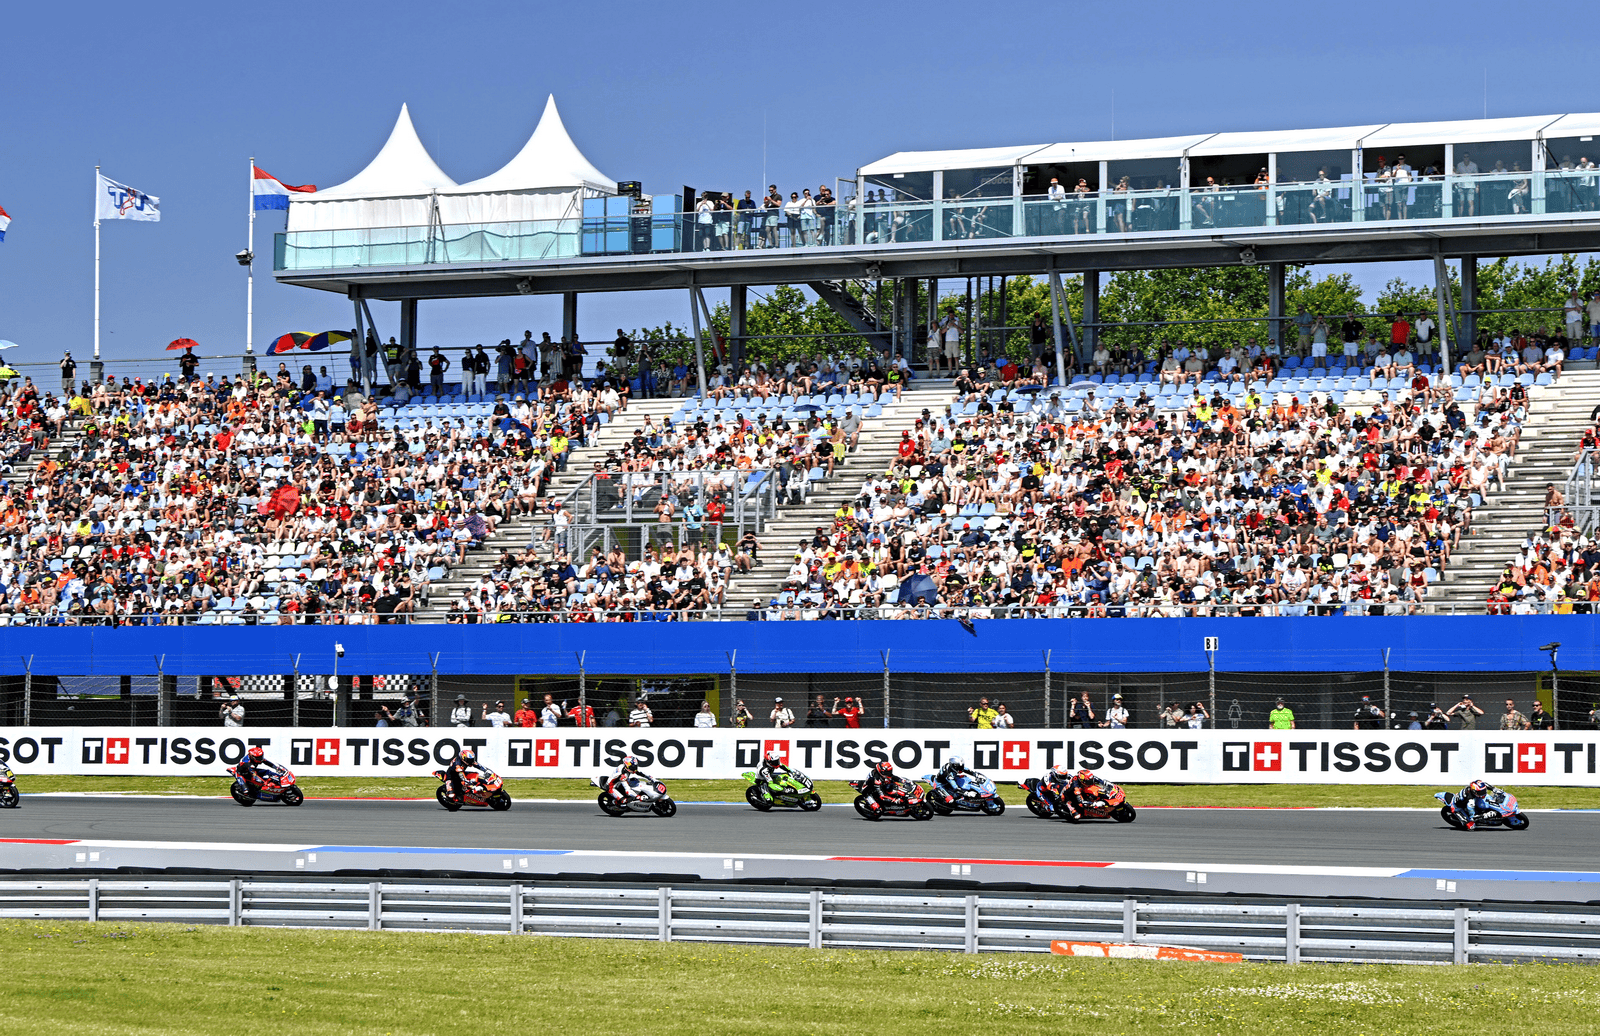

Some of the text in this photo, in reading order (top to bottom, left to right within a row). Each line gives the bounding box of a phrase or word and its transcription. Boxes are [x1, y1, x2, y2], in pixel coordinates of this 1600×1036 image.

[136, 738, 271, 765] TISSOT
[347, 739, 486, 766] TISSOT
[566, 740, 712, 768] TISSOT
[797, 741, 949, 770] TISSOT
[1038, 741, 1197, 770] TISSOT
[1290, 742, 1458, 772] TISSOT
